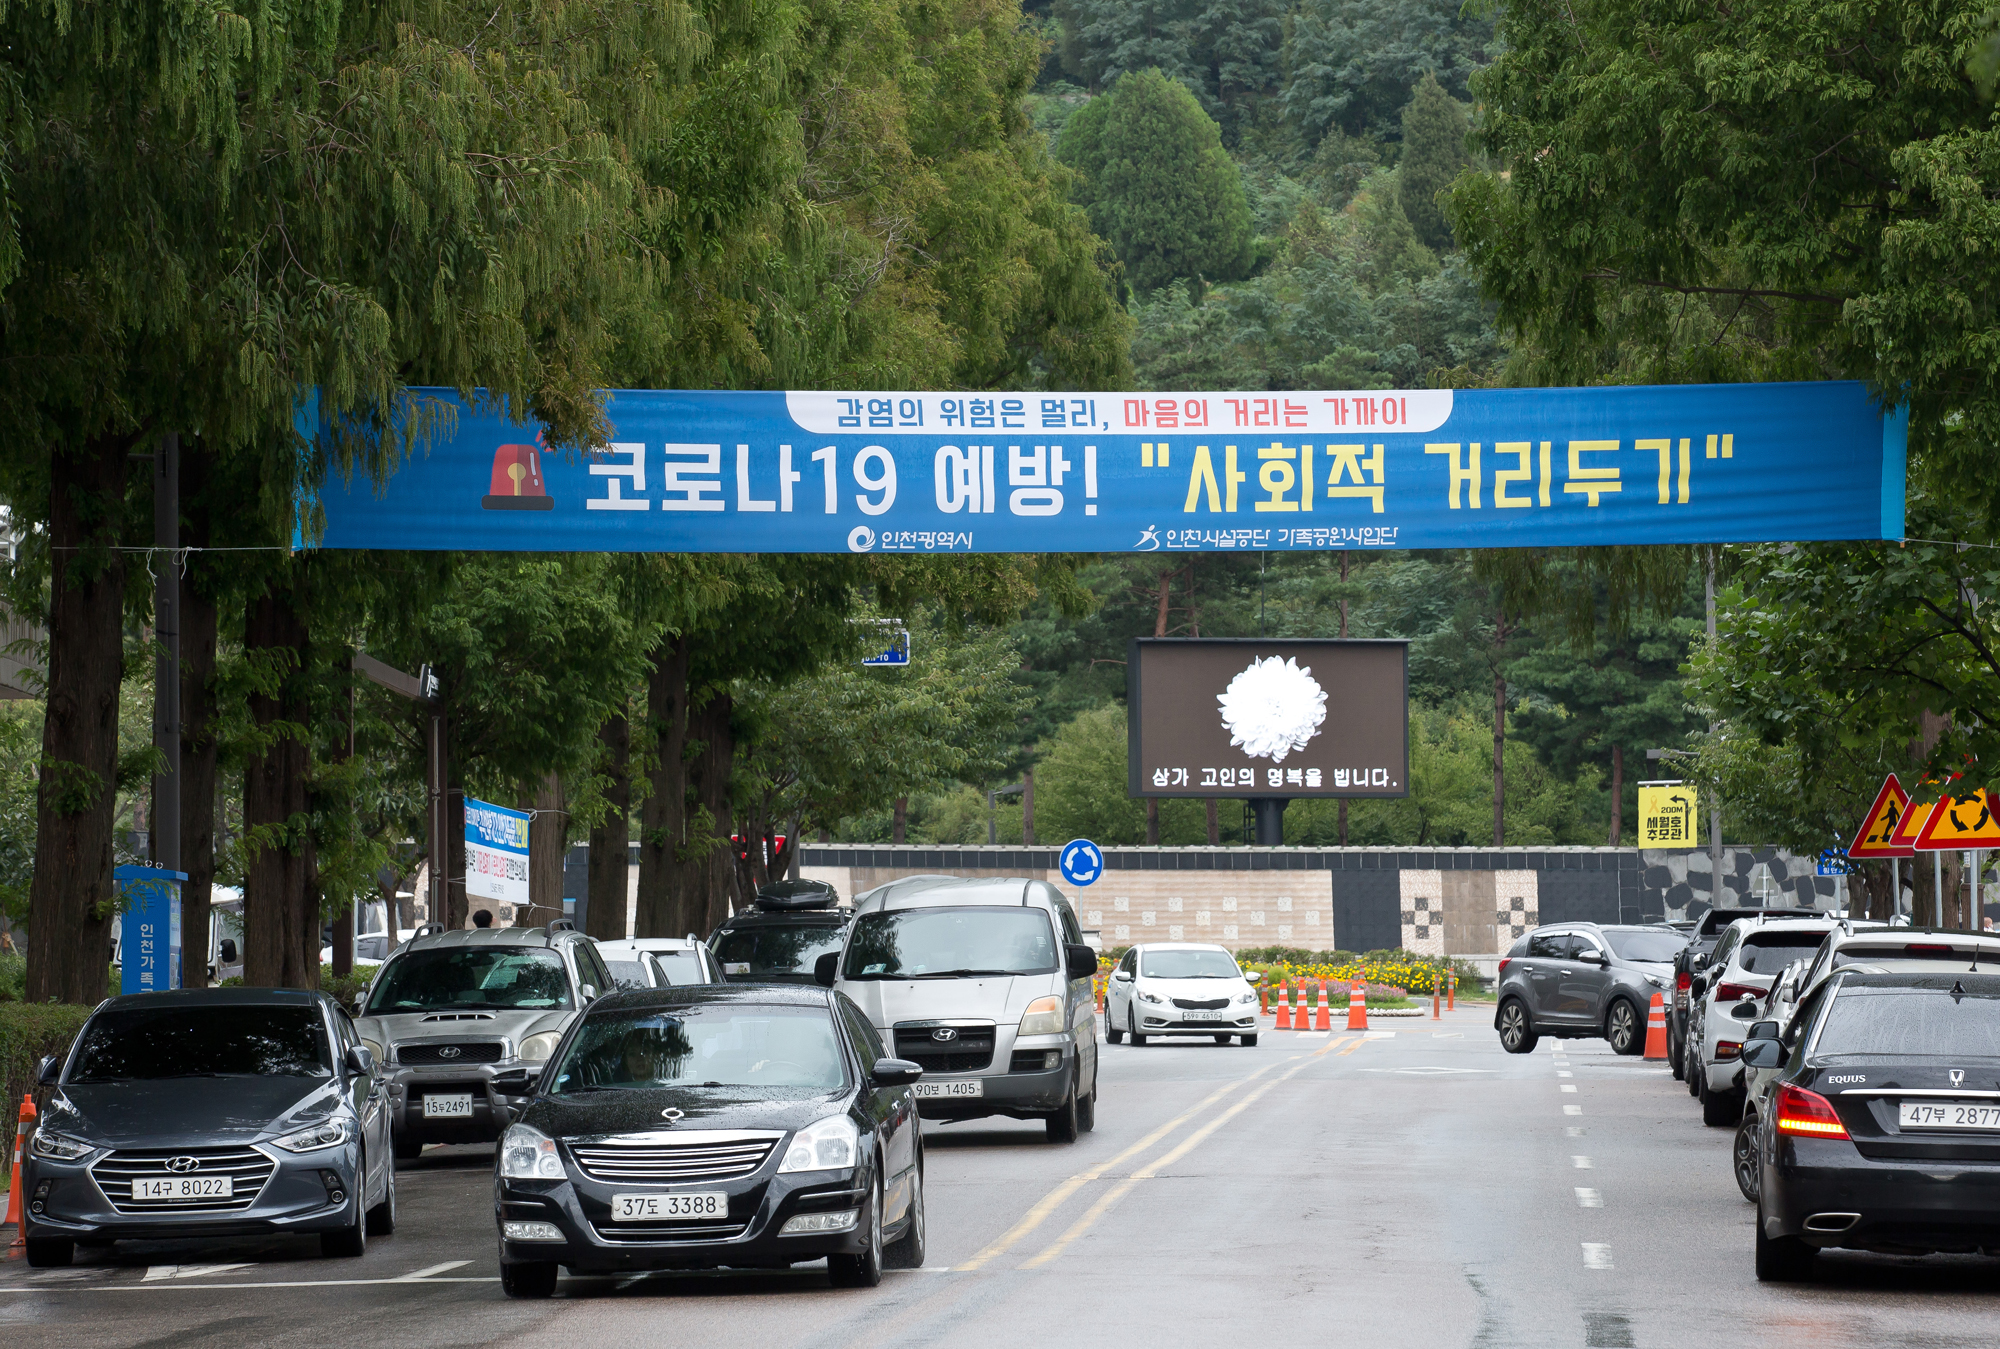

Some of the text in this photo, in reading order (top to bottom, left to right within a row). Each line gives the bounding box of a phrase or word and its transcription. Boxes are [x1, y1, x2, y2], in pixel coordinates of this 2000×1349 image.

[836, 397, 1407, 431] 감염의 위험은 멀리, 마음의 거리는 가까이
[586, 433, 1734, 516] 코로나19 예방! "사회적 거리두기"
[881, 531, 973, 550] 인천광역시
[1166, 527, 1399, 548] 인천시설공단 가족공원사업단
[1152, 767, 1398, 788] 삼가 고인의 명복을 빕니다.
[1660, 806, 1683, 814] 200M
[1646, 816, 1682, 829] 세월호
[1646, 828, 1682, 841] 추모관
[140, 923, 155, 992] 인천가족
[1828, 1074, 1866, 1085] EQUUS
[916, 1083, 975, 1096] 90보 1405
[425, 1101, 470, 1113] 15두2491
[1909, 1107, 2000, 1126] 47부 2877
[142, 1179, 223, 1197] 14구 8022
[622, 1196, 717, 1216] 37도 3388
